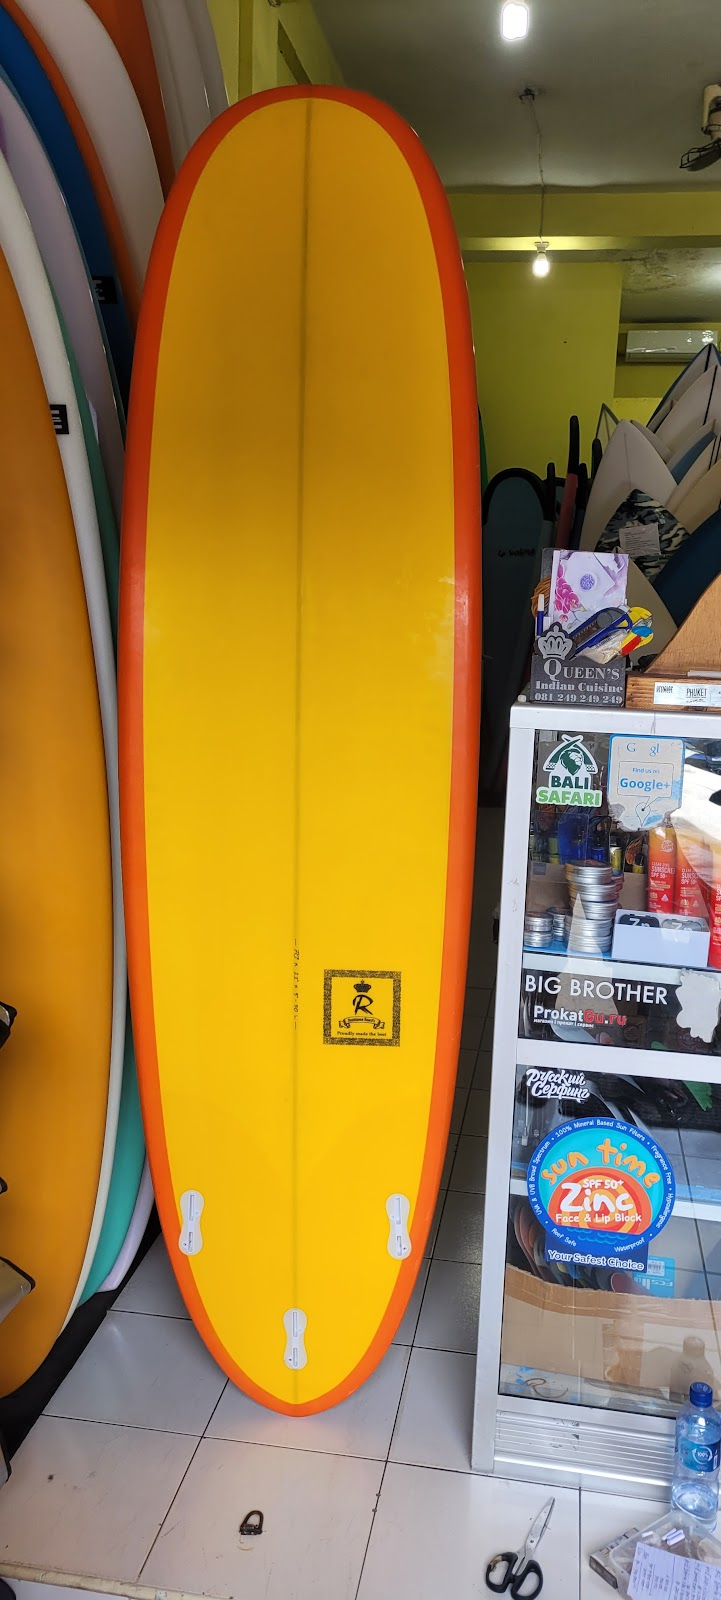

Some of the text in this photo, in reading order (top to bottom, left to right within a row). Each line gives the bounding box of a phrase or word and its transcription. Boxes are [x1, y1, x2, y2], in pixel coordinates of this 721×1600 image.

[543, 659, 620, 682] QUEEN'S
[535, 680, 623, 693] Indian Cuisine
[535, 693, 623, 704] 081 249 249 249
[551, 775, 589, 789] BALI
[620, 777, 670, 791] Google+
[538, 790, 600, 806] SAFARI
[525, 974, 668, 1005] BIG BROTHER
[534, 1005, 626, 1026] ProkatGu.ru
[526, 1068, 586, 1088] Русский
[531, 1080, 590, 1104] Серфинг
[555, 1125, 573, 1138] 100%
[573, 1119, 595, 1129] Mineral
[596, 1118, 614, 1128] Based
[616, 1122, 627, 1131] Sun
[629, 1127, 646, 1141] Filters
[534, 1140, 551, 1165] Spectrum
[650, 1145, 669, 1171] Fragrance
[541, 1137, 661, 1188] sun time
[528, 1166, 536, 1183] Broad
[582, 1179, 624, 1189] SPF 50+
[560, 1182, 634, 1213] Zinc
[555, 1213, 642, 1224] Face & Lip Block
[655, 1193, 674, 1229] Hypoallergenic
[551, 1227, 578, 1247] Reef Safe
[613, 1236, 645, 1253] Waterproof
[547, 1249, 573, 1262] Your
[572, 1252, 607, 1266] Safest
[607, 1257, 645, 1271] Choice
